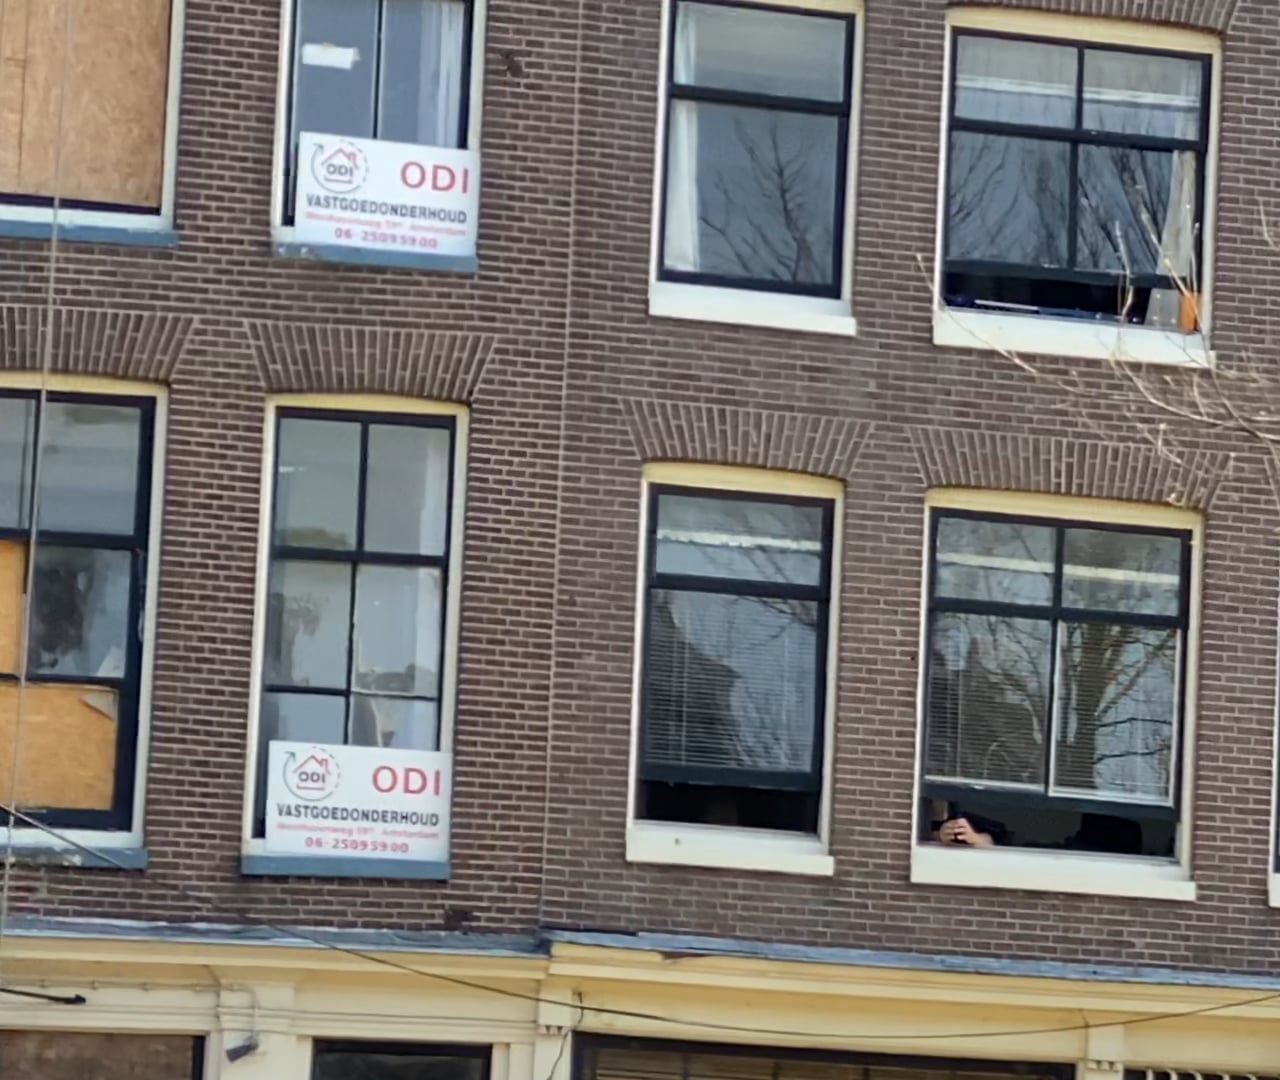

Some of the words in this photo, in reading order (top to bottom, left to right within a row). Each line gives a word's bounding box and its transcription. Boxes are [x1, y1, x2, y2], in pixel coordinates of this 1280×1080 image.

[326, 162, 354, 177] ODI
[400, 160, 470, 194] ODI
[305, 192, 468, 224] VASTGOEDONDERHOUD
[297, 771, 327, 785] ODI
[371, 765, 441, 796] ODI
[276, 802, 440, 827] VASTGOEDONDERHOUD
